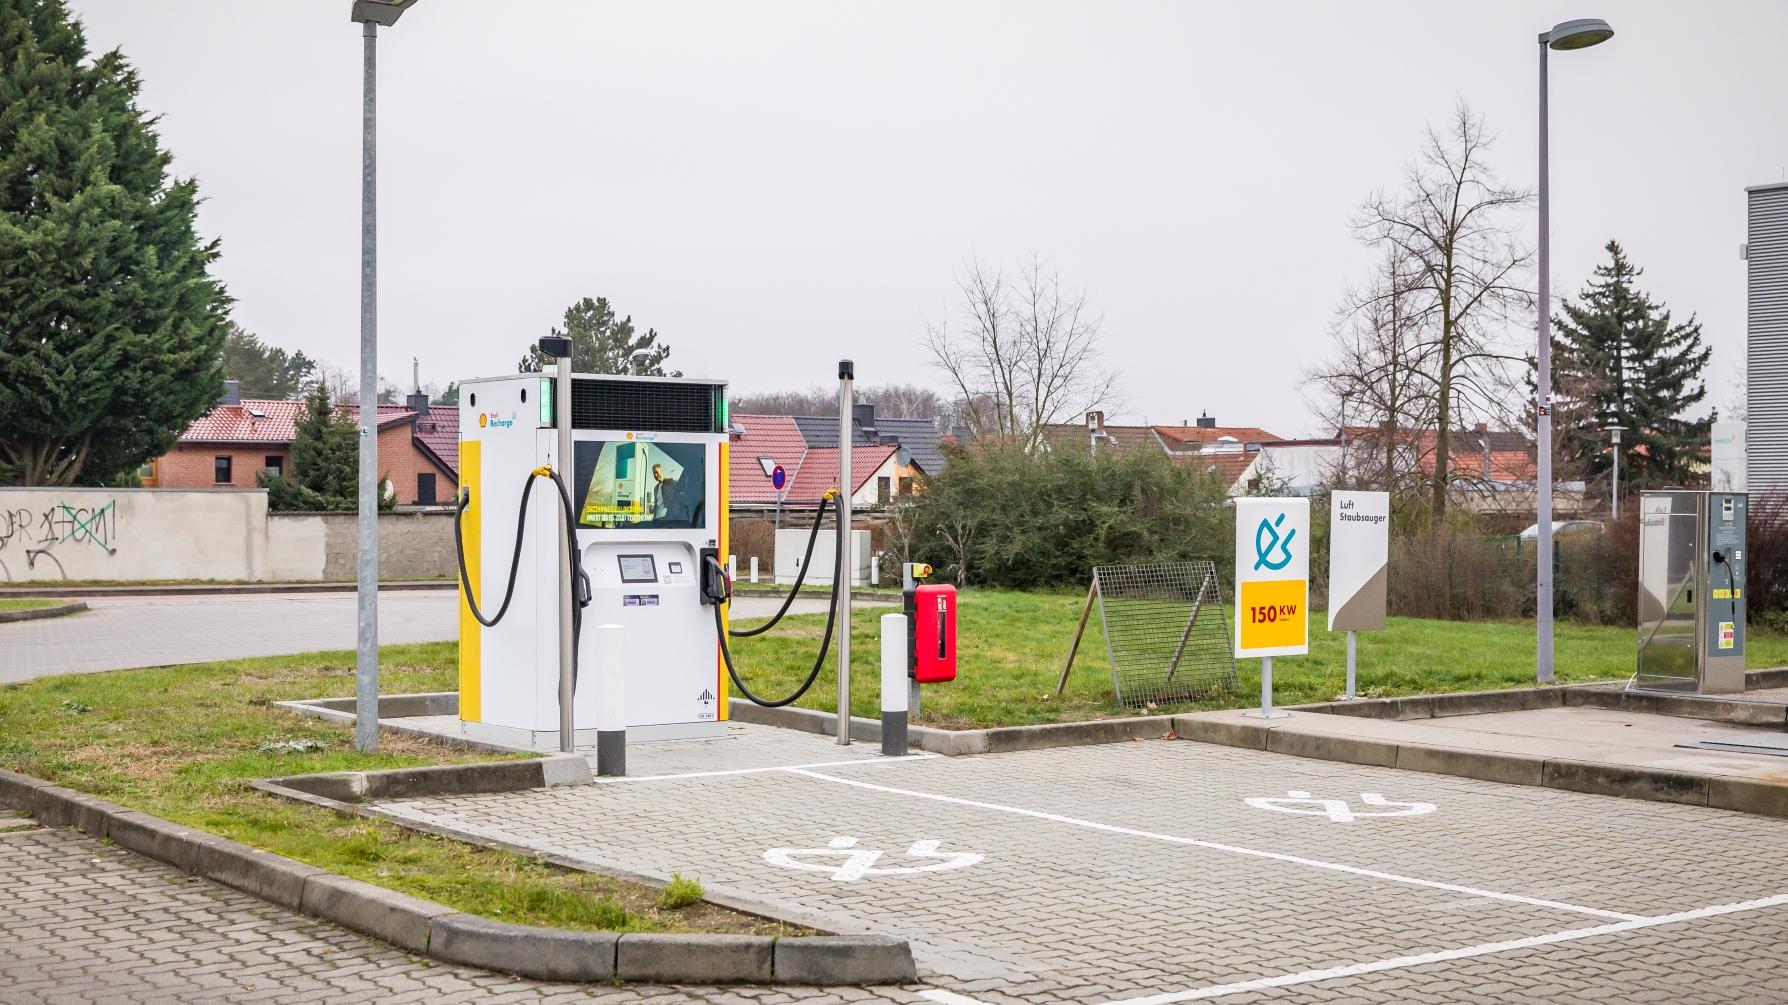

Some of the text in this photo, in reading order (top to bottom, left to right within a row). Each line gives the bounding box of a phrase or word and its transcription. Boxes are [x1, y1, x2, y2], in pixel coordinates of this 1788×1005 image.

[490, 419, 513, 428] Recharge
[1340, 499, 1354, 509] Luft
[1339, 511, 1386, 524] Staubsauger
[1251, 605, 1297, 623] 150 KW
